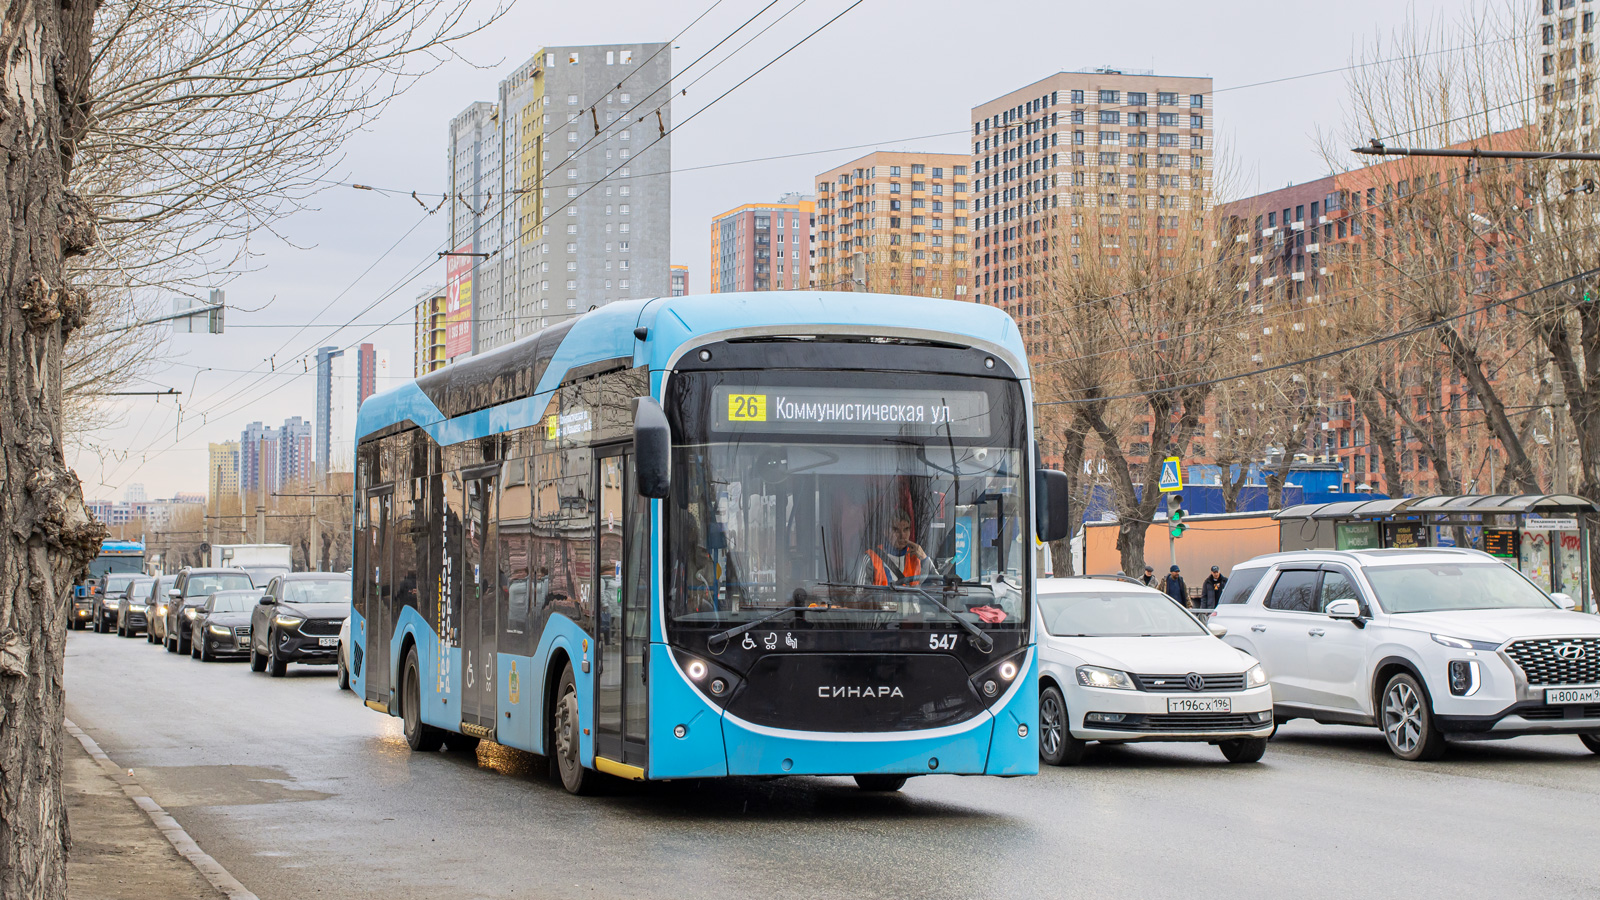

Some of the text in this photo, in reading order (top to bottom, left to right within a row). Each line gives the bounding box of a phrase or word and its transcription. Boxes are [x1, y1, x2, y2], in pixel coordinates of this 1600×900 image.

[734, 395, 954, 424] 26 Коммунистическая ул.
[581, 584, 590, 602] 547
[445, 557, 453, 693] реформа
[929, 633, 957, 650] 547
[818, 686, 904, 698] СИНАРА
[1552, 690, 1600, 702] Н800АМ 9
[1172, 699, 1227, 711] Т196СХ 196
